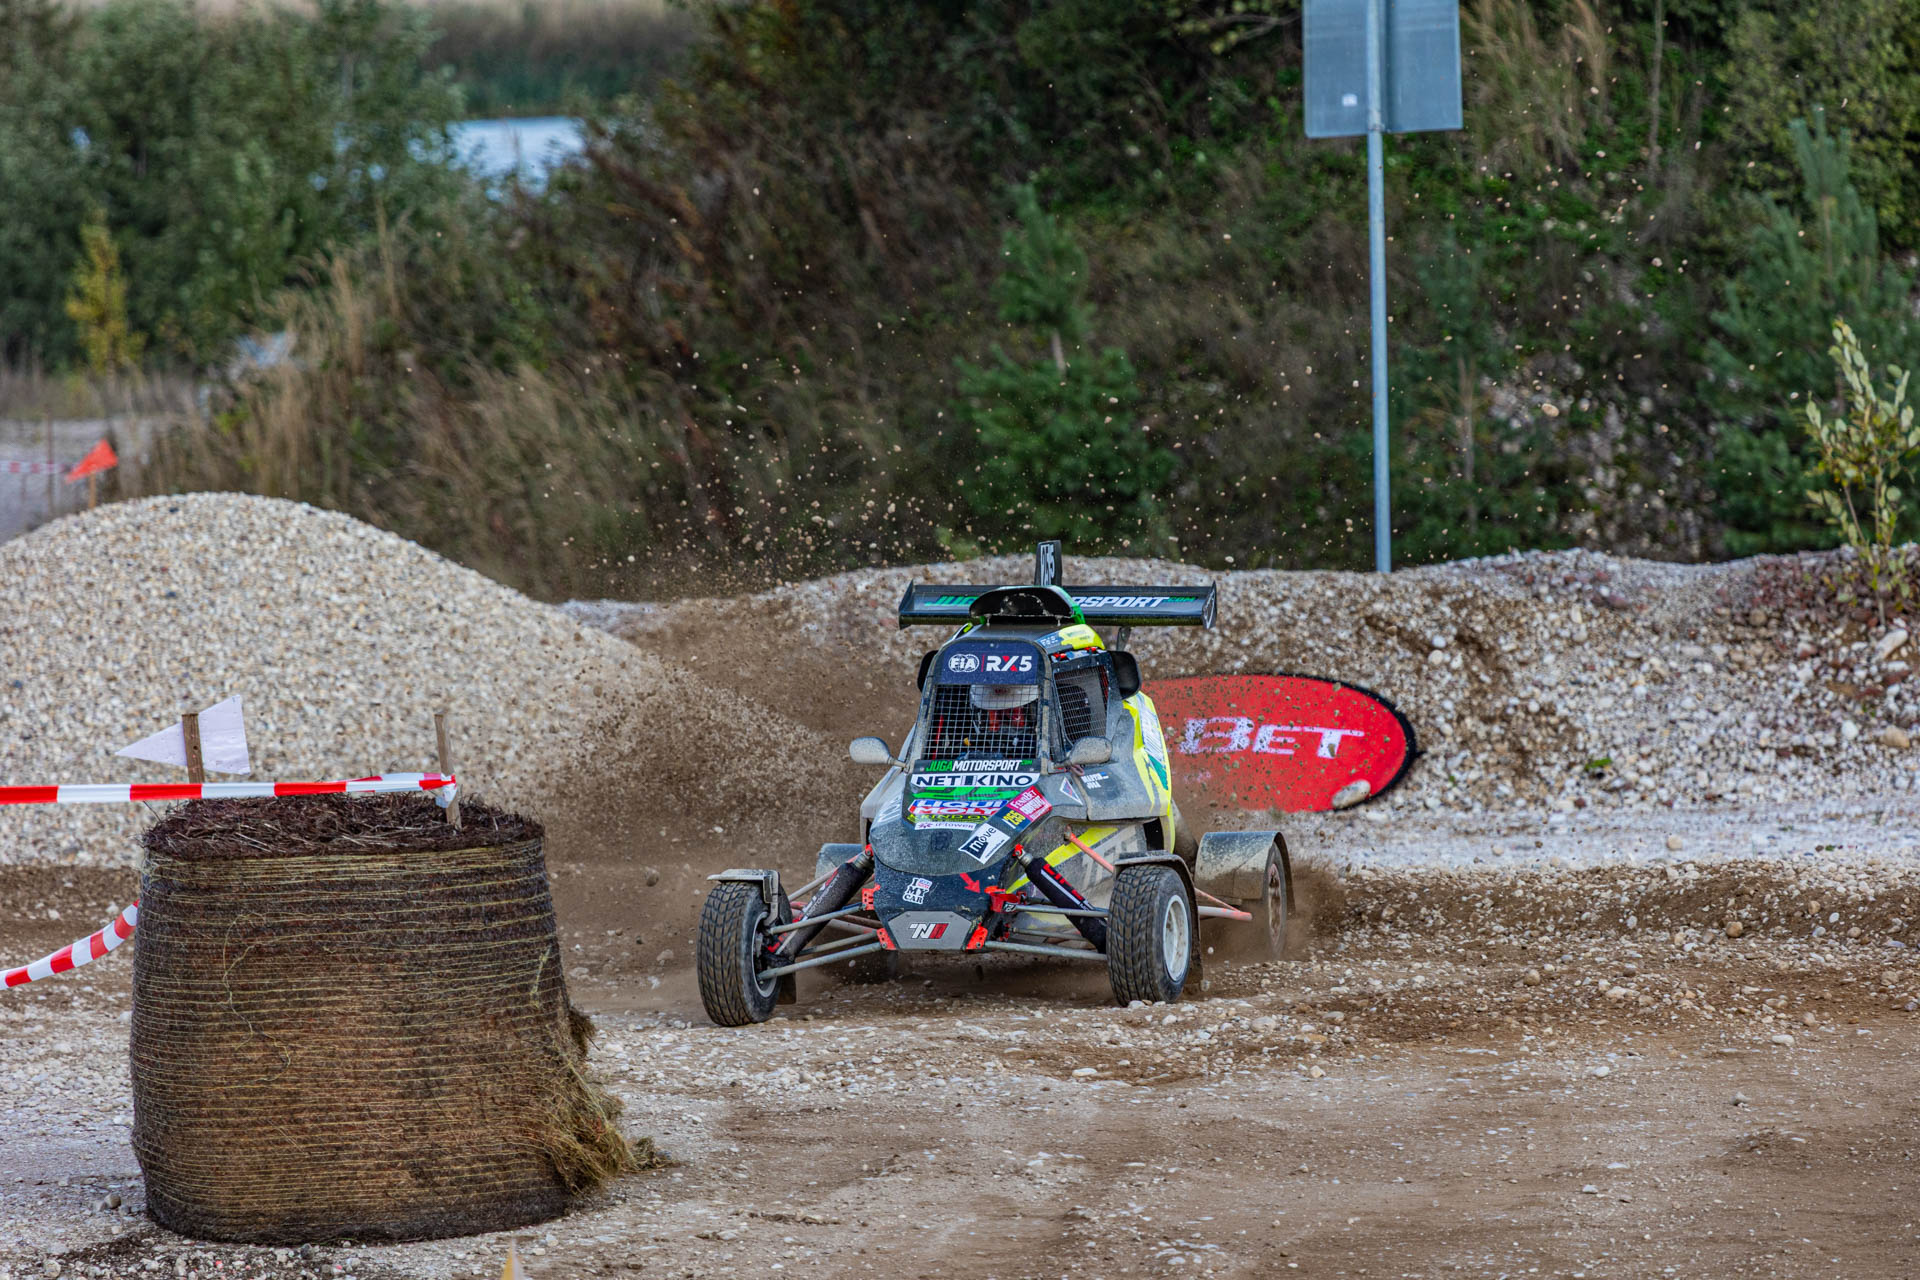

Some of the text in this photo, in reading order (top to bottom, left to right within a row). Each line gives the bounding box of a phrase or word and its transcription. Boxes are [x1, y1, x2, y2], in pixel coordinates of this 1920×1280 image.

[986, 655, 1032, 672] RX5
[969, 827, 997, 852] move
[905, 885, 929, 897] MY
[903, 893, 923, 904] CAR
